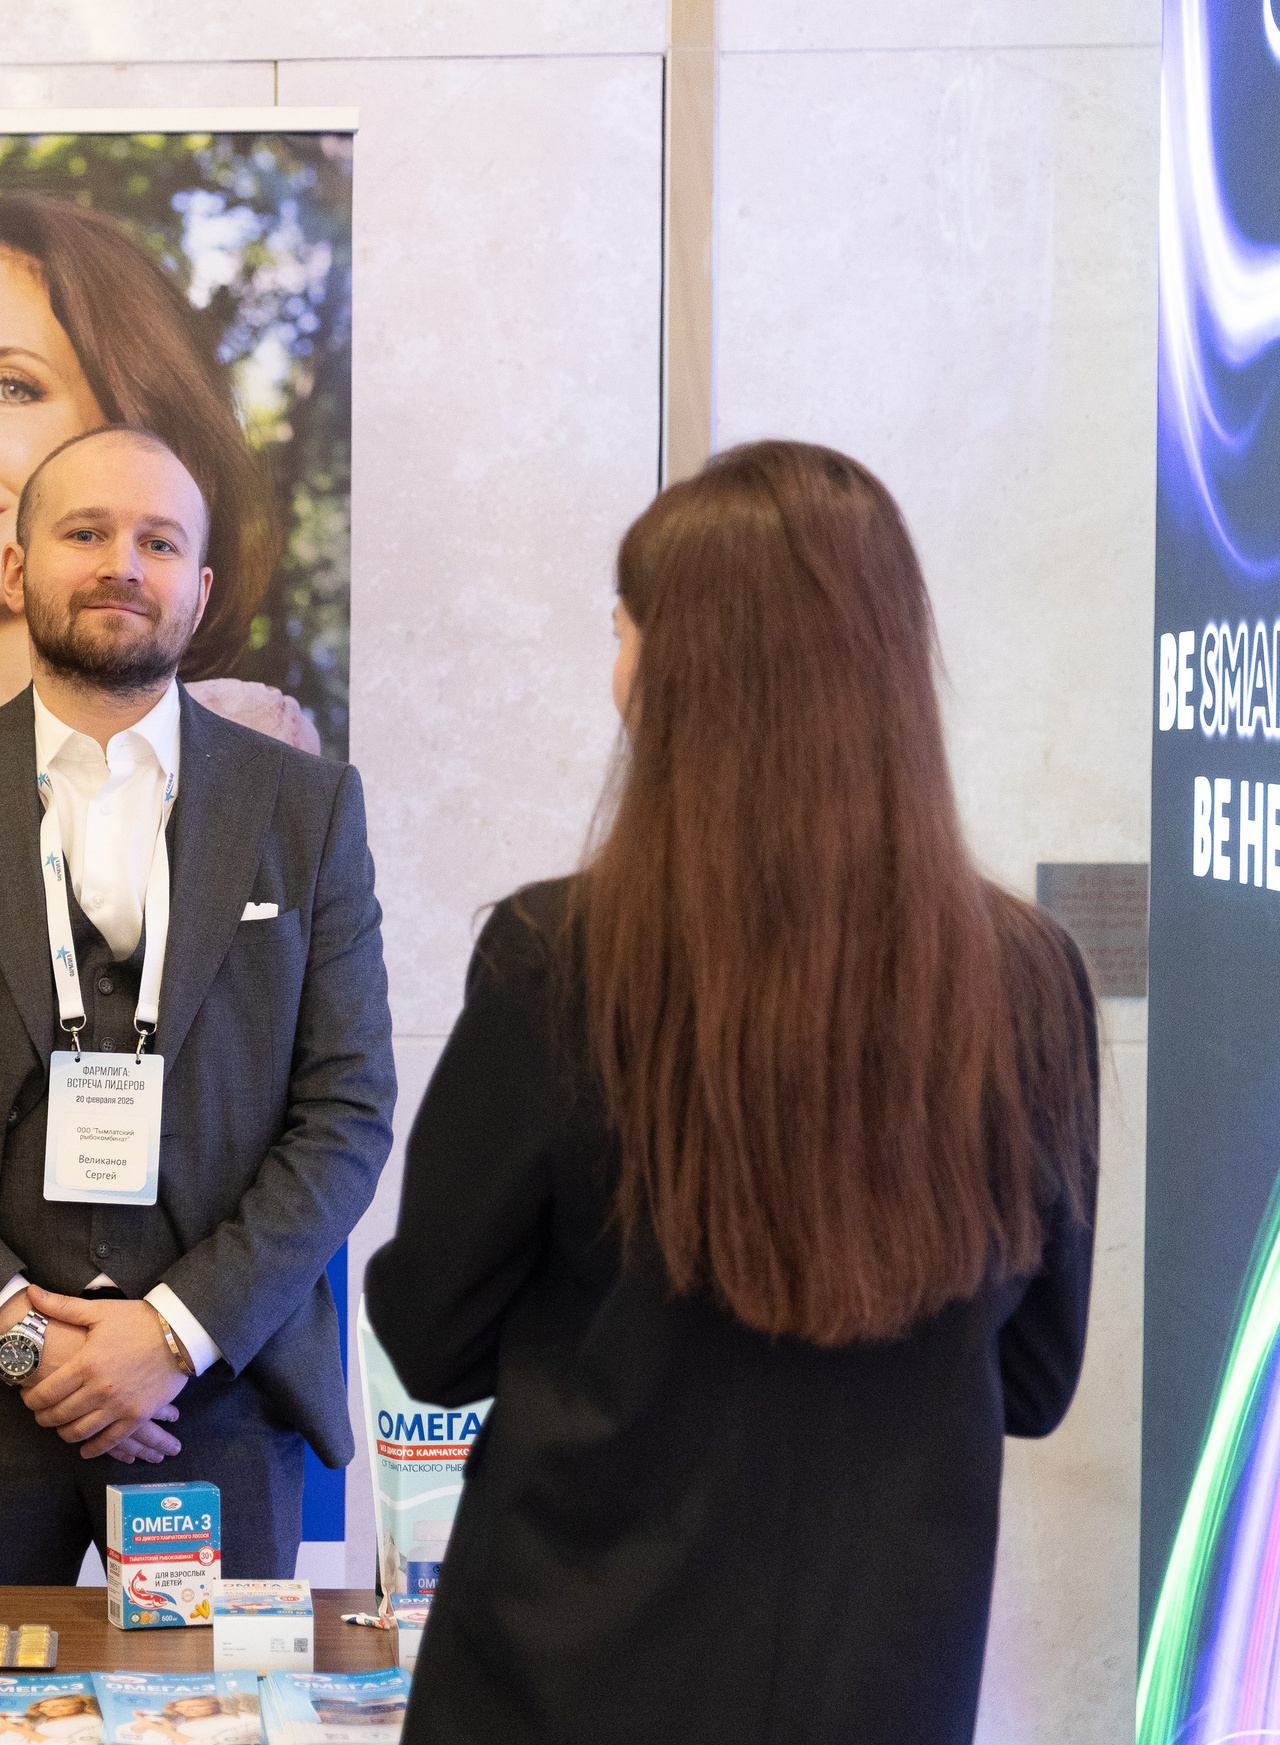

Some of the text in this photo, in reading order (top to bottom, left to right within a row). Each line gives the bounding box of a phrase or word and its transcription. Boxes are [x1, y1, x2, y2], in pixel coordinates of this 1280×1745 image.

[1159, 622, 1280, 736] BE SMA
[1192, 776, 1232, 881] BE
[82, 1066, 131, 1077] ФАРМЛИГА:
[66, 1077, 145, 1091] ВСТРЕЧА ЛИДЕРОВ
[75, 1095, 135, 1105] 20 февраля 2025
[78, 1154, 127, 1166] Великанов
[85, 1169, 117, 1181] Сергей
[416, 1448, 470, 1457] КАМЧАТСКО
[154, 1569, 206, 1579] ДЛЯ ВЗРОСЛЫХ
[161, 1579, 182, 1588] ДЕТЕЙ
[161, 1614, 173, 1622] 600
